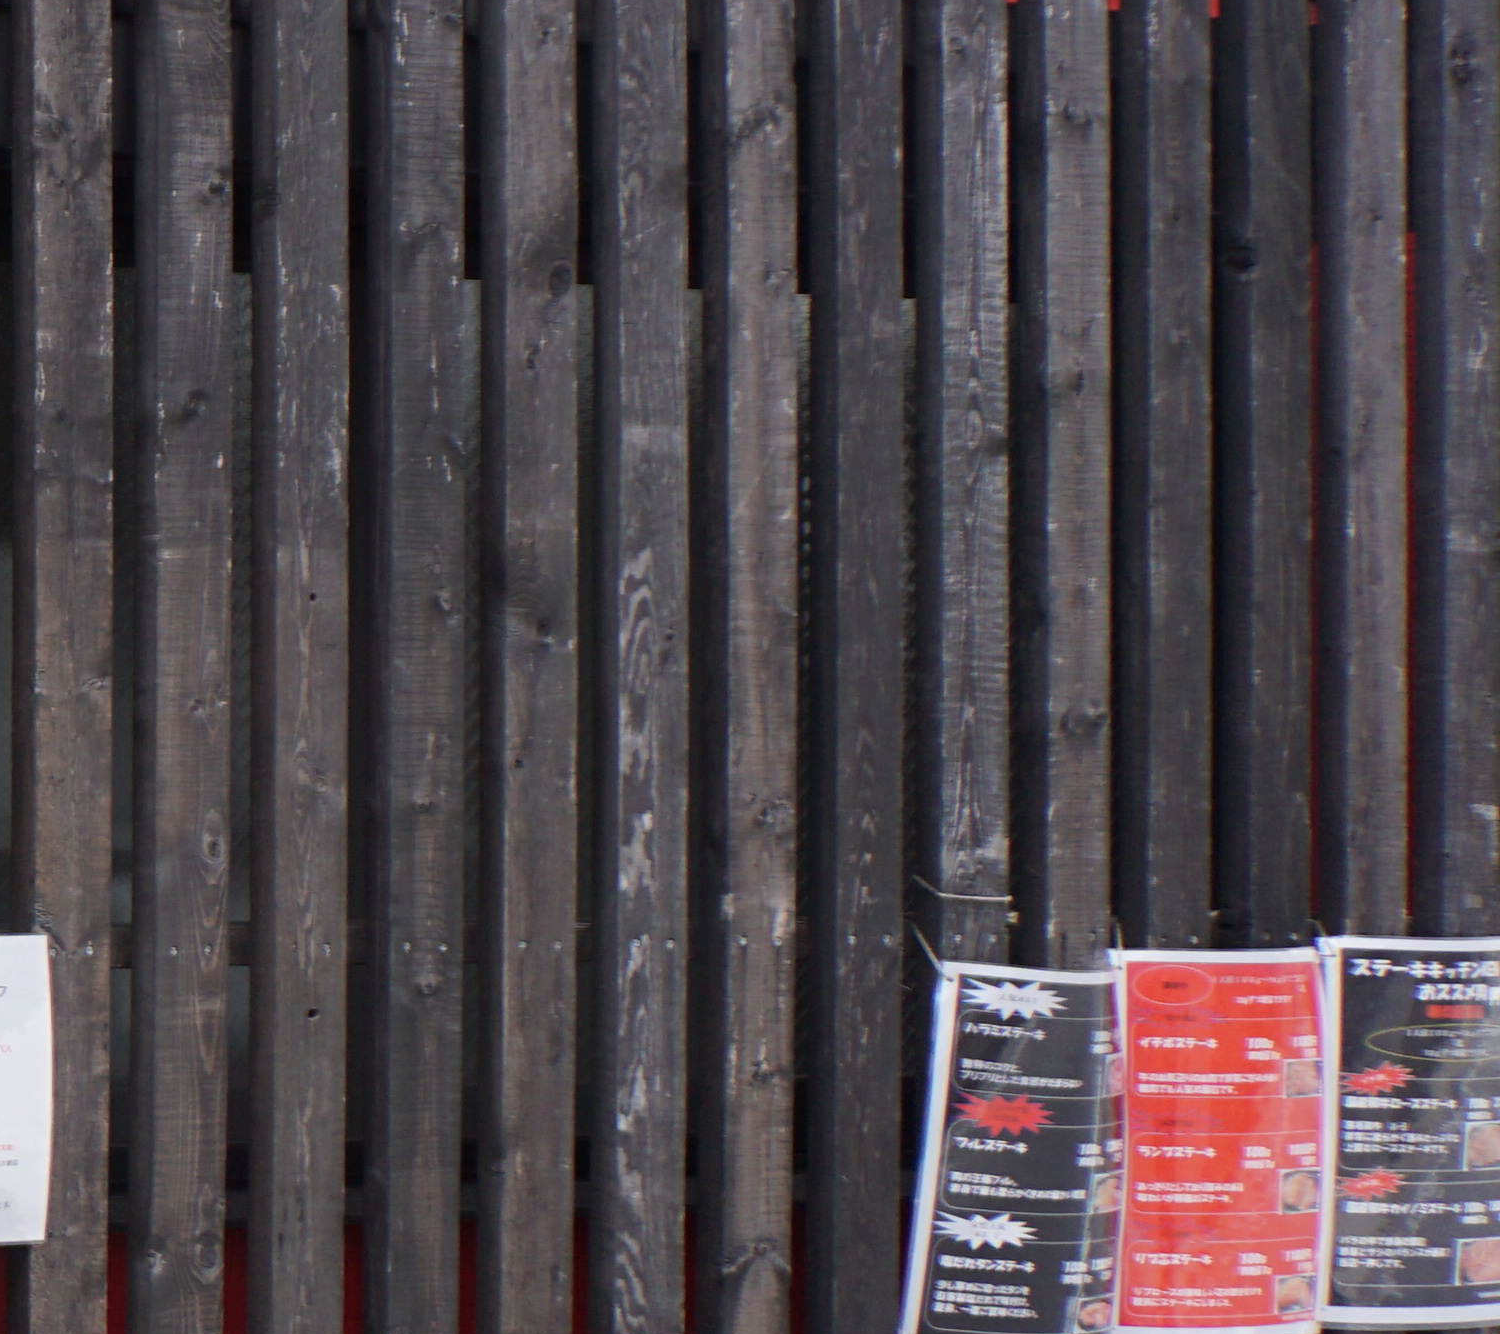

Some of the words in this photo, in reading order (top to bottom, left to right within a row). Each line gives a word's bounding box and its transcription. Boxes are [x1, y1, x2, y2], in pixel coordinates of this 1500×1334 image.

[963, 1021, 1048, 1041] ハラミステーキ
